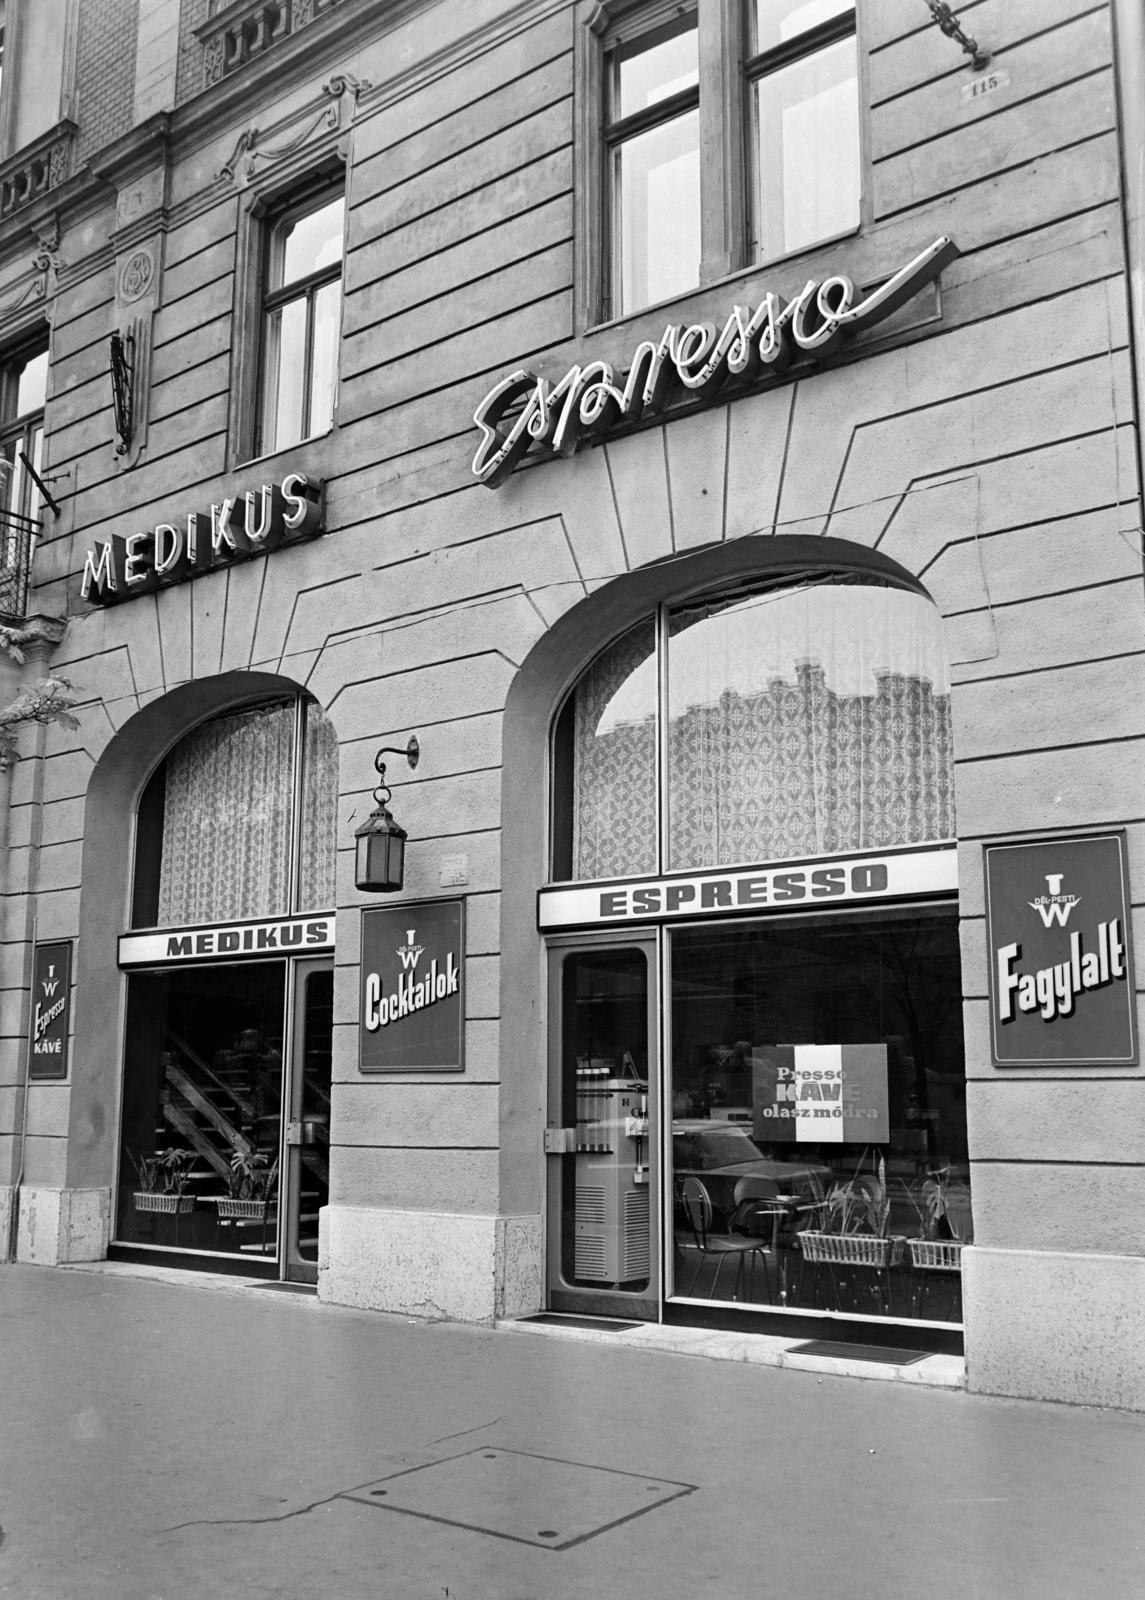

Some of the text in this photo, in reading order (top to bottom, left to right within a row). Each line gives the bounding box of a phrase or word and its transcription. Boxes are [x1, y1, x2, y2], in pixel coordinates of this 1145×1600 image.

[972, 76, 998, 97] 115
[472, 235, 952, 486] Espresso
[80, 471, 312, 604] MEDIKUS
[600, 863, 889, 917] ESPRESSO
[1034, 894, 1076, 905] DÉL-PESTI
[166, 921, 329, 957] MEDIKUS
[997, 917, 1125, 1022] Fagylalt
[365, 951, 459, 1032] Cocktailok
[34, 997, 66, 1041] Espresso
[34, 1038, 62, 1054] KÁVÉ
[776, 1067, 848, 1081] Presso
[776, 1080, 861, 1102] KÁVÉ
[763, 1103, 878, 1118] olasz módra
